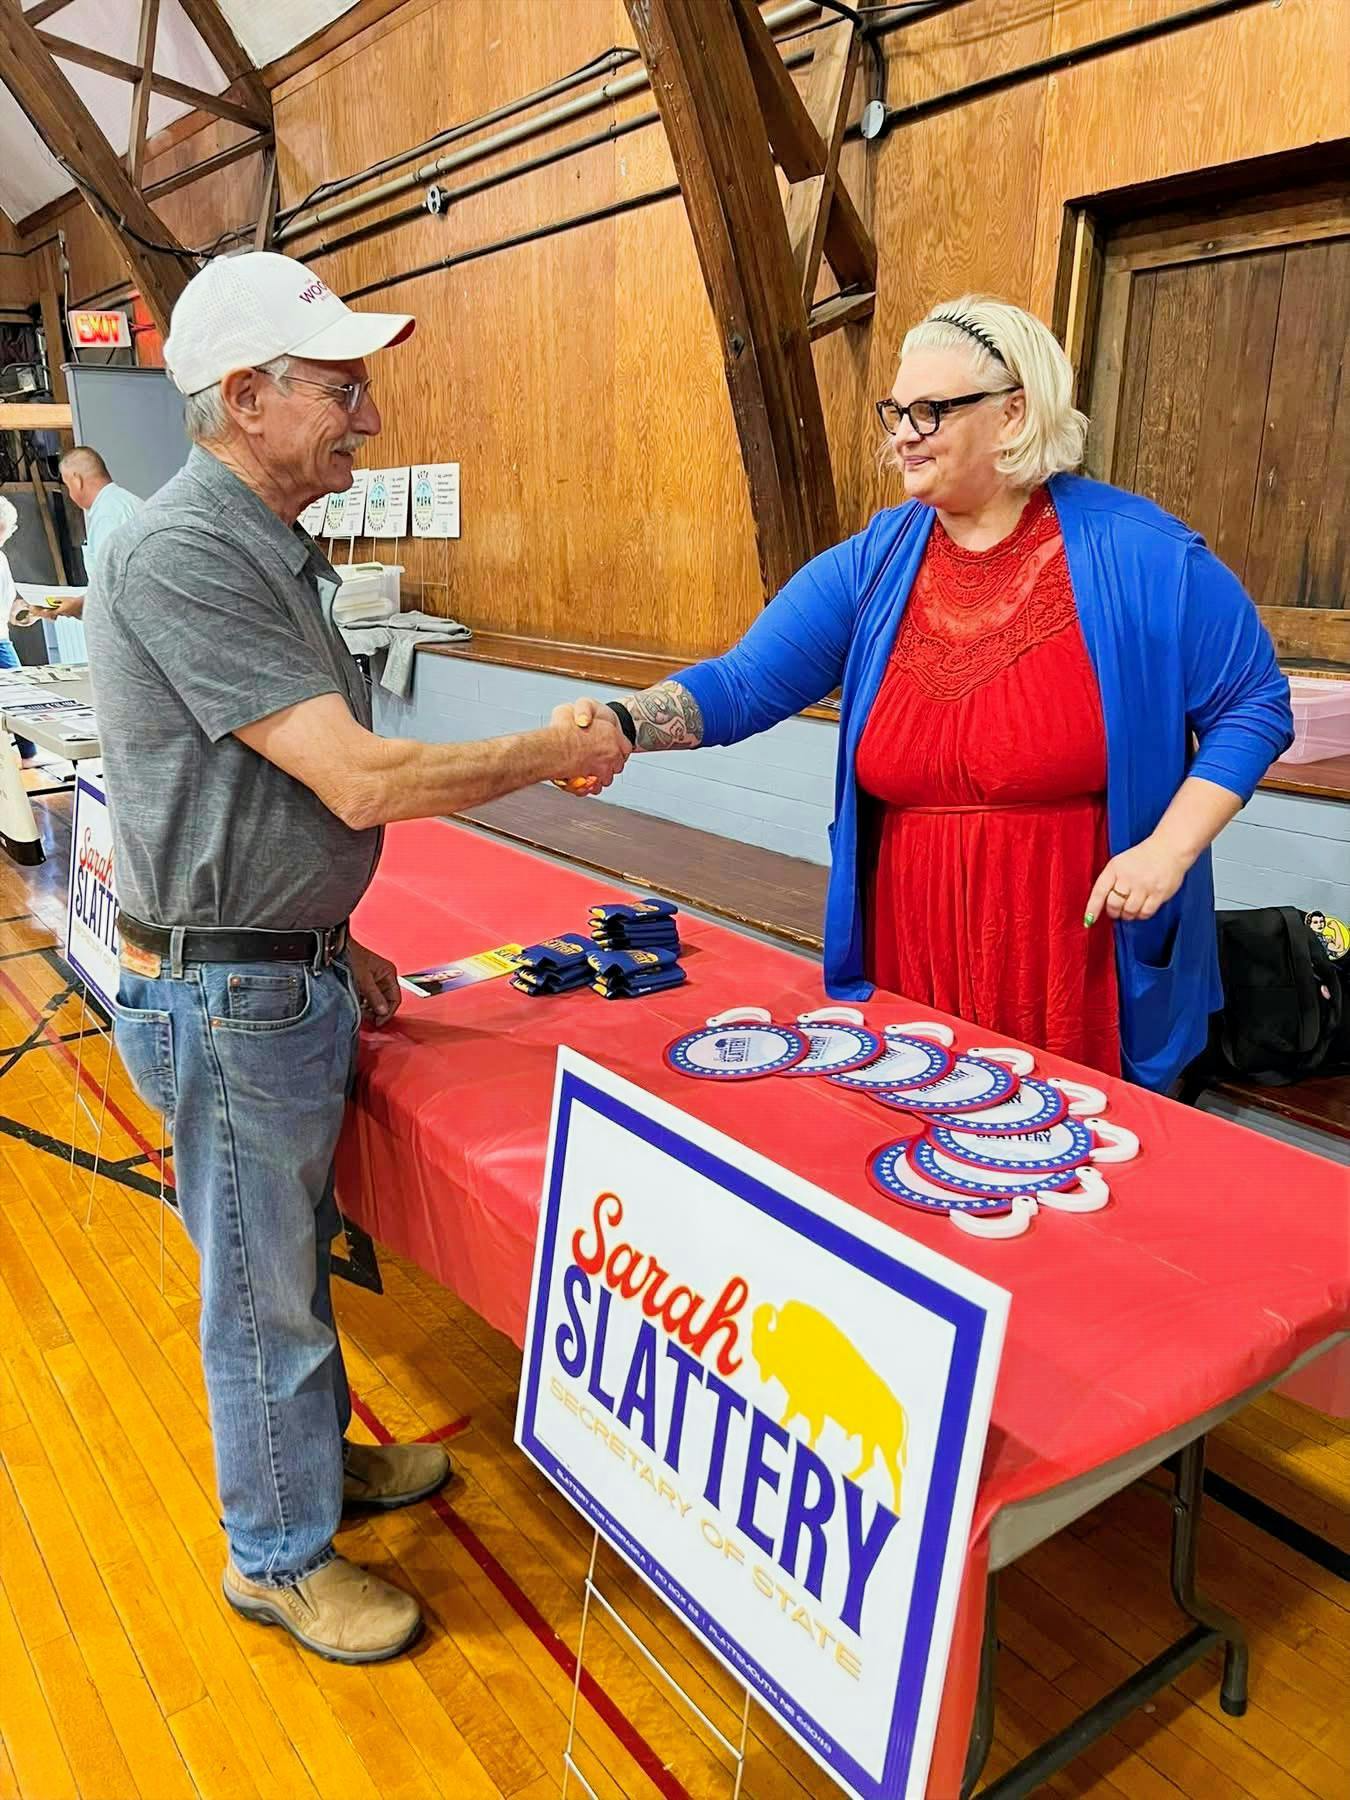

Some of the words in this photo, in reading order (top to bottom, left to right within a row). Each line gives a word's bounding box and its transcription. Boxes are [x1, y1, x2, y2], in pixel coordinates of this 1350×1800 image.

[75, 313, 120, 343] EXIT
[79, 827, 115, 889] Sarah
[571, 1192, 749, 1376] Sarah
[556, 1264, 900, 1639] SLATTERY
[556, 1468, 589, 1505] SLATTERY
[590, 1503, 606, 1523] FOR
[605, 1519, 646, 1563] NEBRASKA
[550, 1377, 692, 1517] SECRETARY
[700, 1519, 746, 1564] OF
[752, 1563, 862, 1681] STATE
